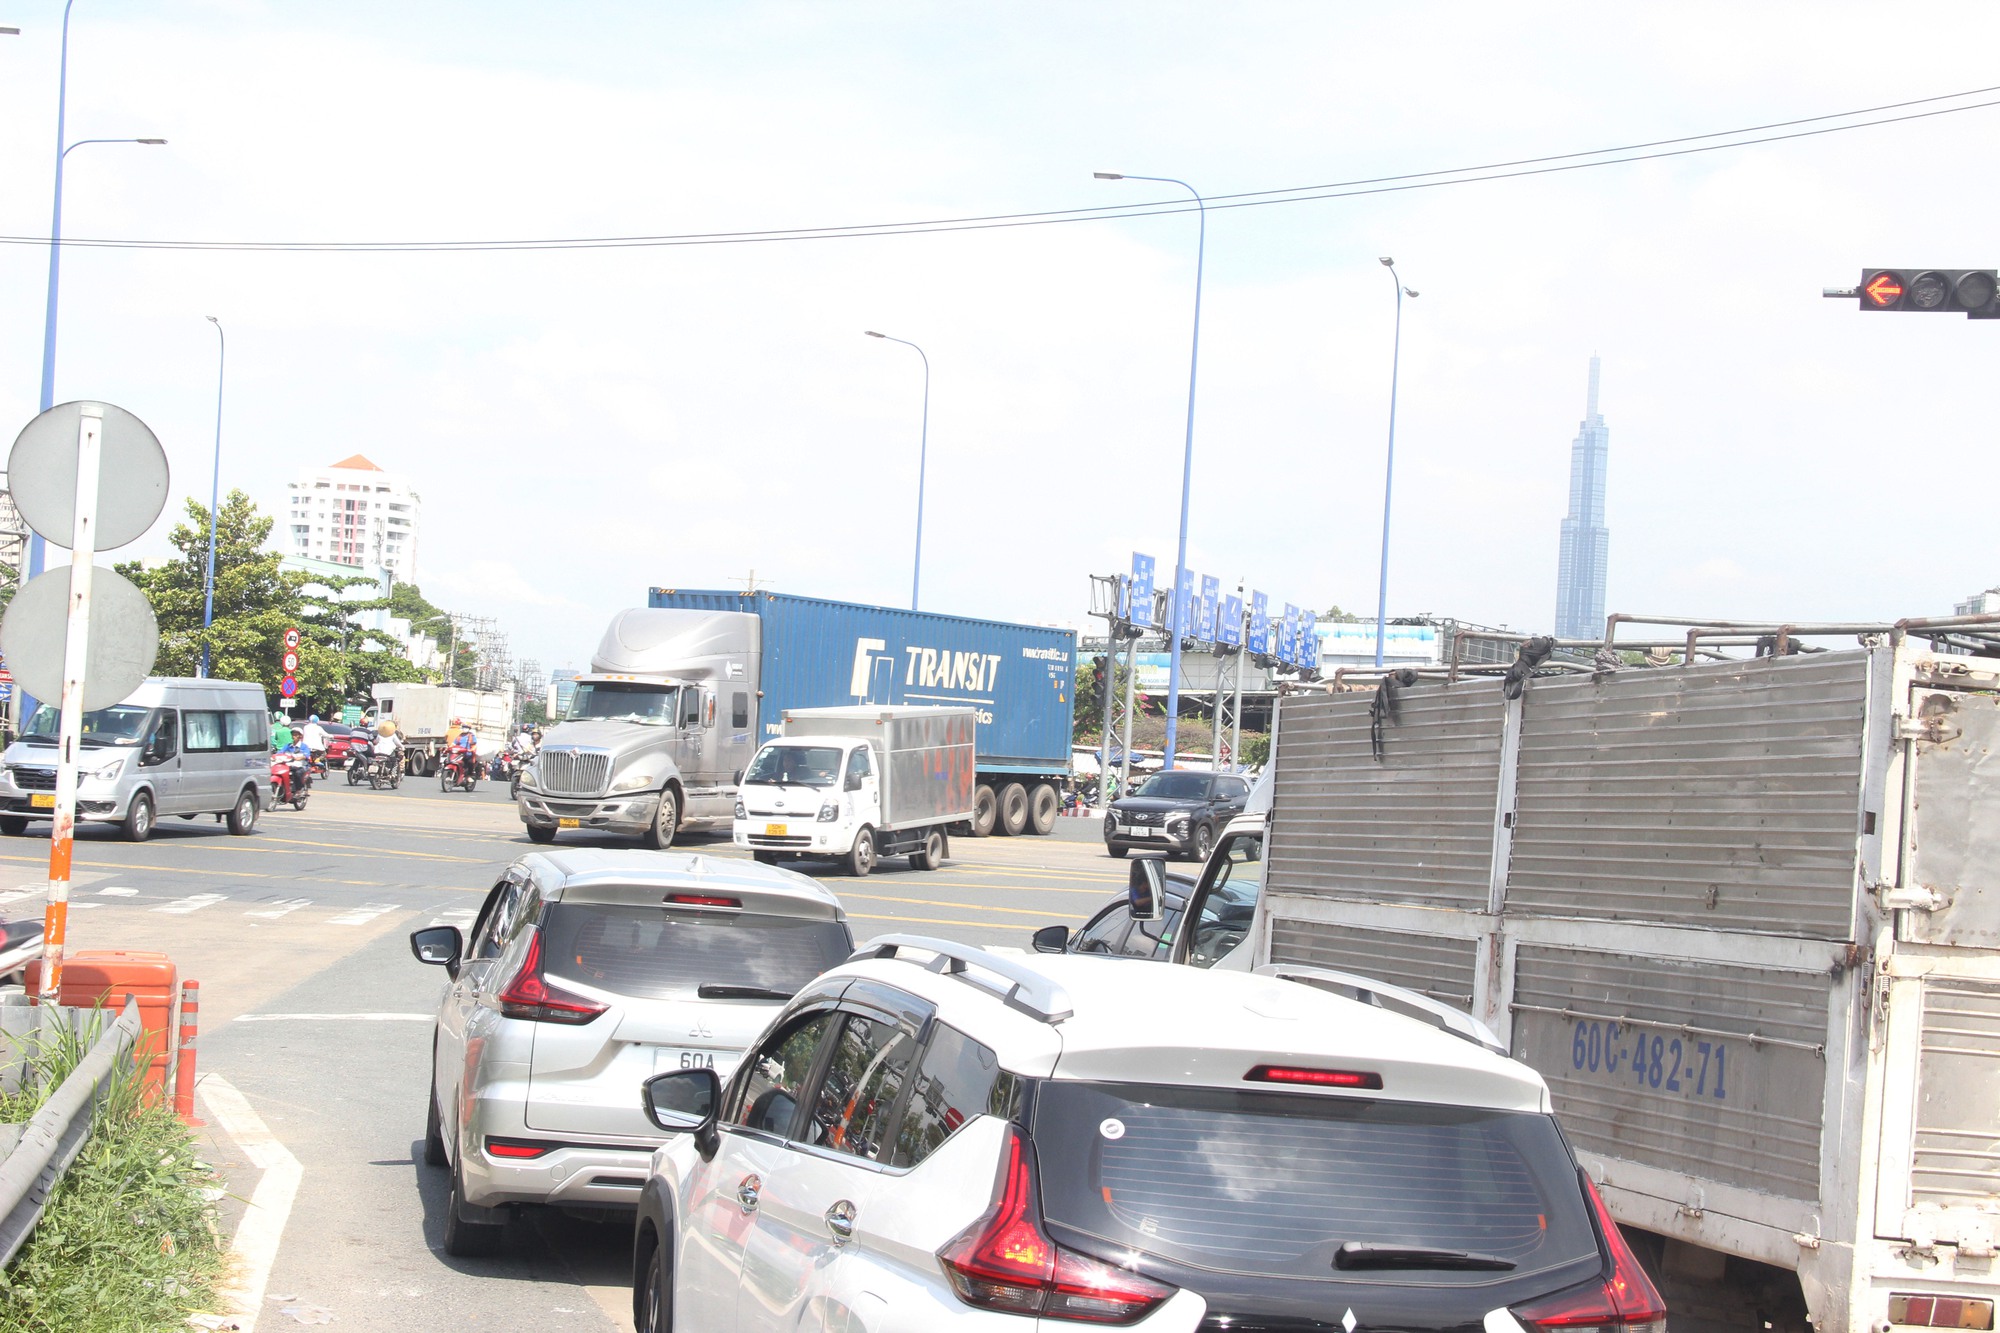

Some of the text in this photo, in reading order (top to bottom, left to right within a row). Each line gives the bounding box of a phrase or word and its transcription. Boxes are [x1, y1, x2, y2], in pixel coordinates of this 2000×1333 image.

[287, 657, 295, 668] 50
[906, 646, 1002, 693] TRANSIT
[680, 1052, 714, 1069] 60A
[1573, 1020, 1726, 1099] 60C-482-71
